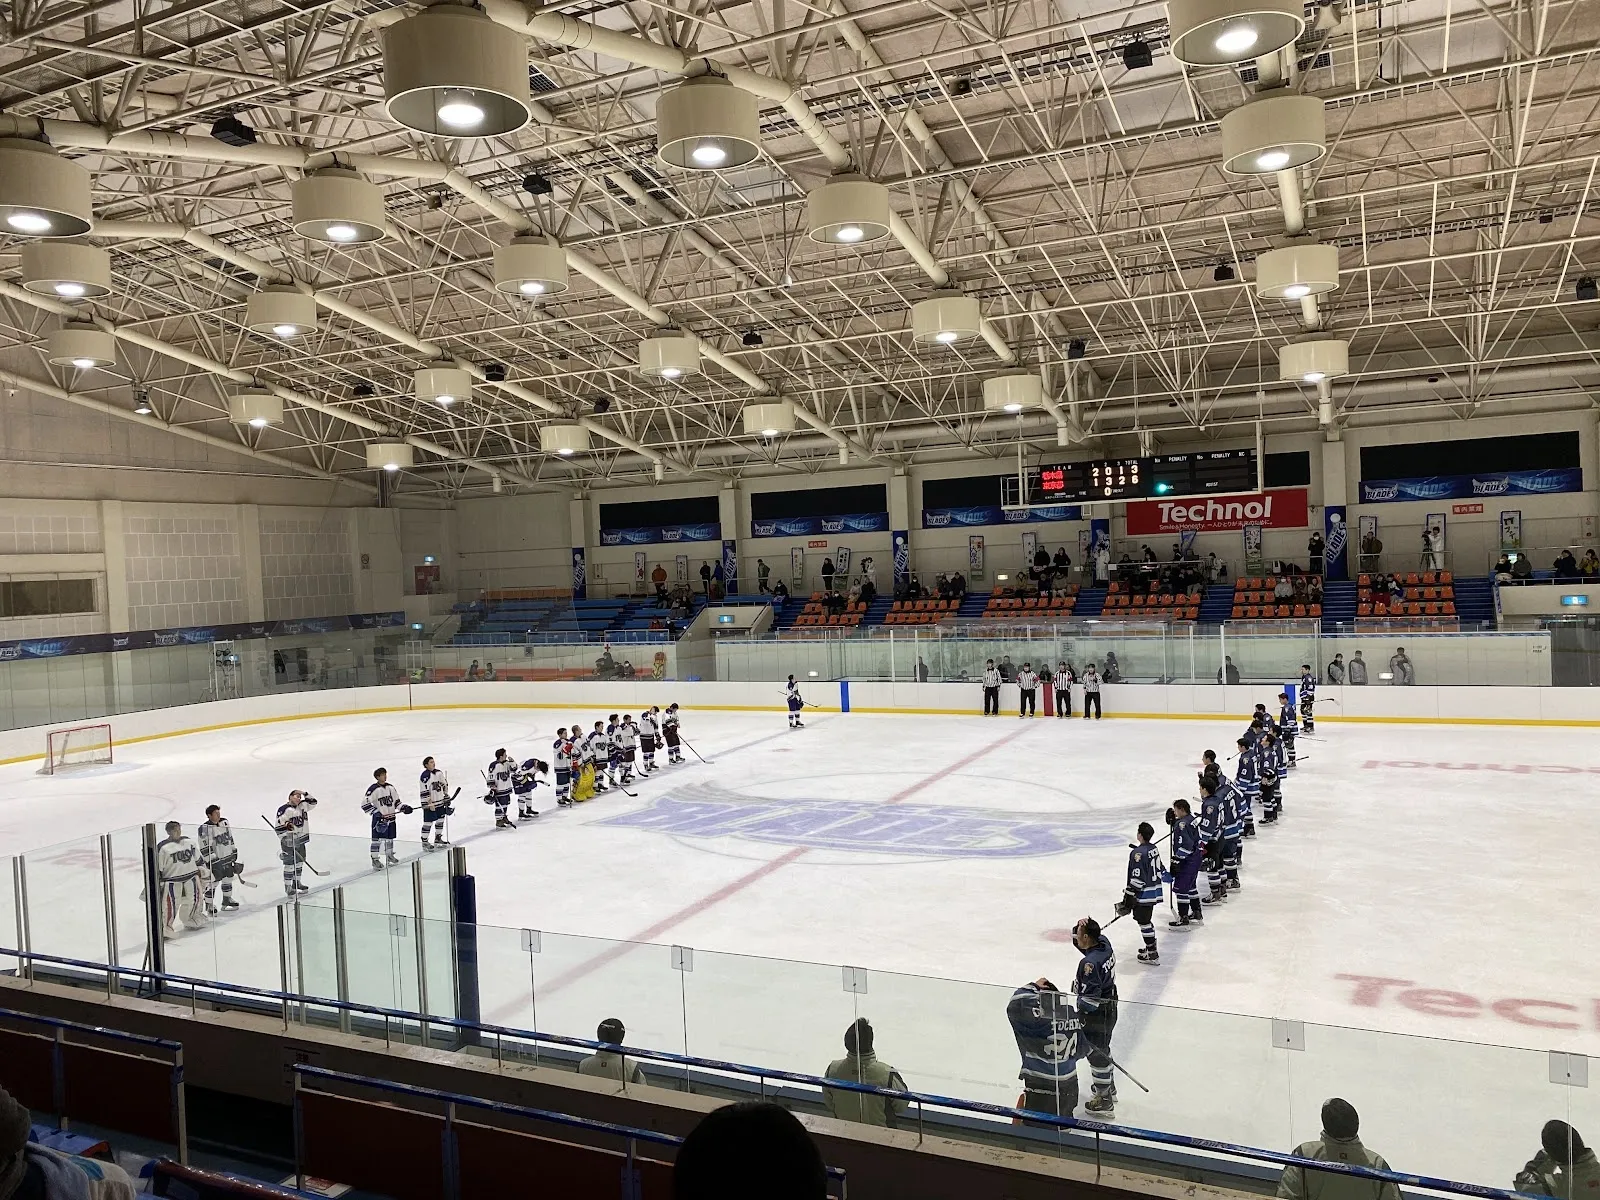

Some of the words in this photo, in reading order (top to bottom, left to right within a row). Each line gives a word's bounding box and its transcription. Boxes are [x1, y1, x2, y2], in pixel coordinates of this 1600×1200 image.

[1092, 468, 1099, 476] 2
[1105, 467, 1112, 475] 0
[1119, 466, 1124, 474] 1
[1131, 465, 1138, 473] 3
[1094, 478, 1098, 486] 1
[1106, 477, 1112, 485] 3
[1118, 476, 1125, 485] 2
[1131, 475, 1138, 484] 6
[1104, 487, 1111, 496] 0
[1473, 482, 1508, 493] BLADES
[1366, 488, 1397, 499] BLADES
[1158, 496, 1272, 523] Technol
[1326, 523, 1347, 562] BLADES
[894, 545, 908, 579] BLADES
